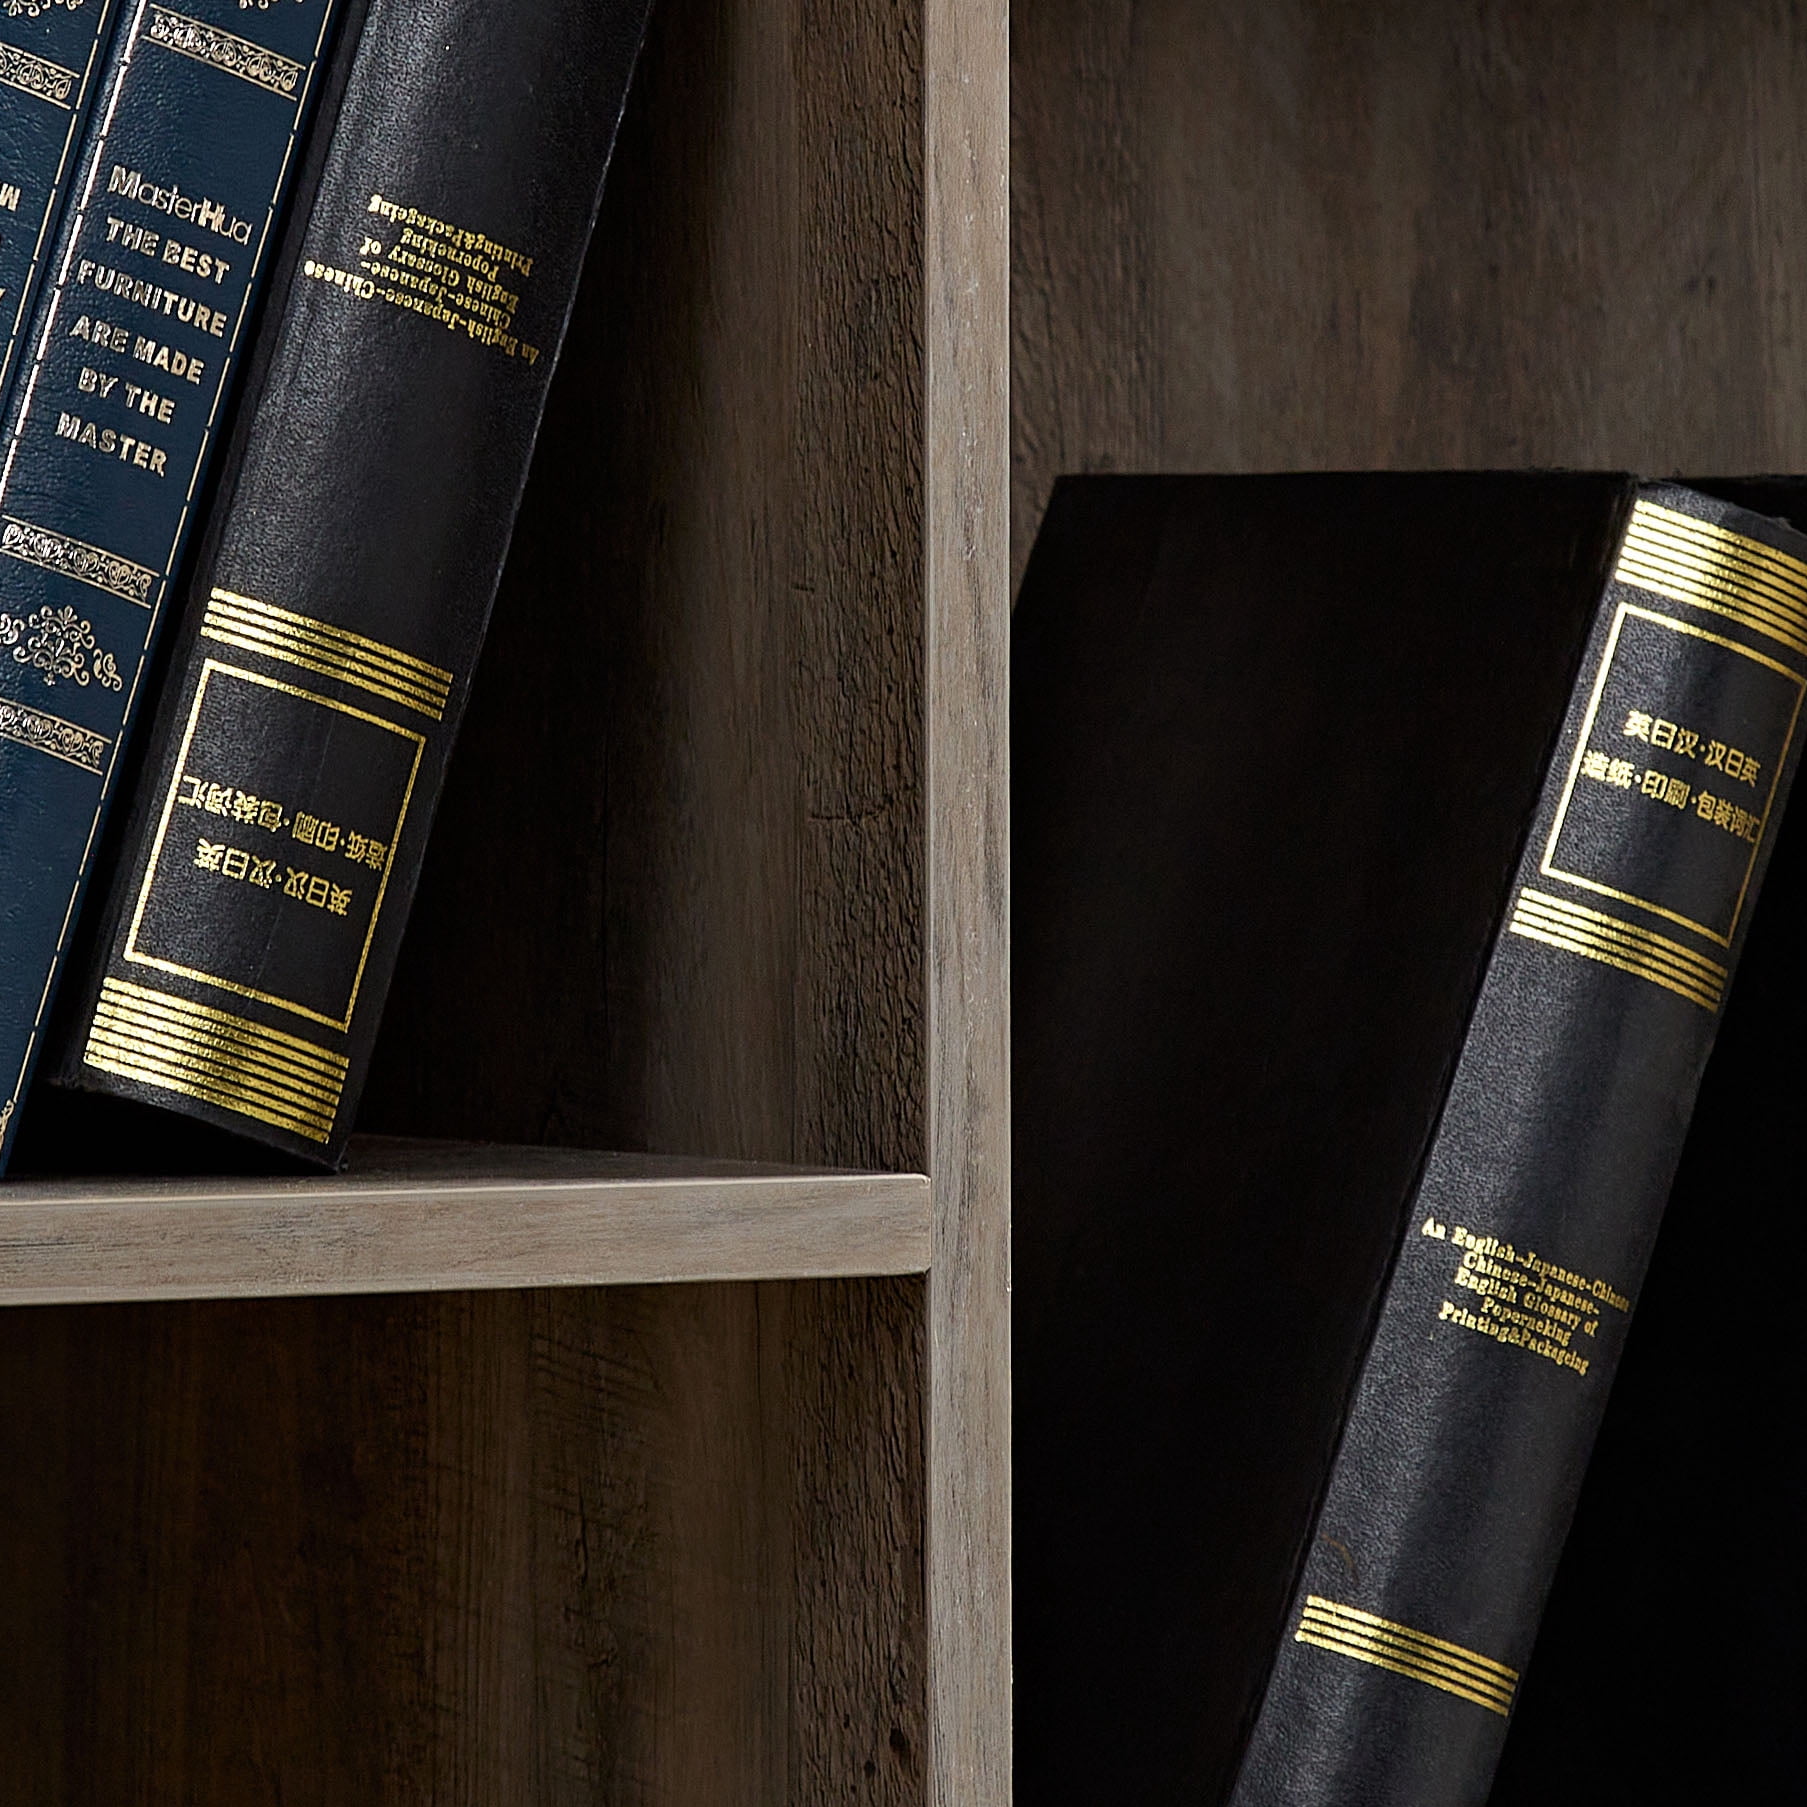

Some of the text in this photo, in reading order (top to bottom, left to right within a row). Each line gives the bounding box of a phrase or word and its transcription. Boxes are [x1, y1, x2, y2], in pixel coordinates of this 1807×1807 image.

[106, 164, 253, 246] MasterHua
[106, 216, 230, 285] THE BEST
[360, 235, 520, 314] English Glossary of
[77, 258, 228, 338] FURNITURE
[303, 259, 540, 366] An English-Japanese-Chinese
[360, 260, 511, 330] Chinese-Japanese-
[69, 314, 206, 385] ARE MADE
[78, 366, 175, 424] BY THE
[55, 411, 168, 478] MASTER
[1622, 709, 1761, 788] 英日汉·汉日英
[177, 774, 388, 872] 造纸·印刷·包装词汇
[1579, 748, 1761, 843] 造纸·印刷·包装词汇
[193, 837, 353, 916] 英日汉·汉日英
[1421, 1216, 1447, 1241] An
[1454, 1265, 1599, 1338] English Glossary of
[1462, 1250, 1601, 1316] Chinese-Japanese-
